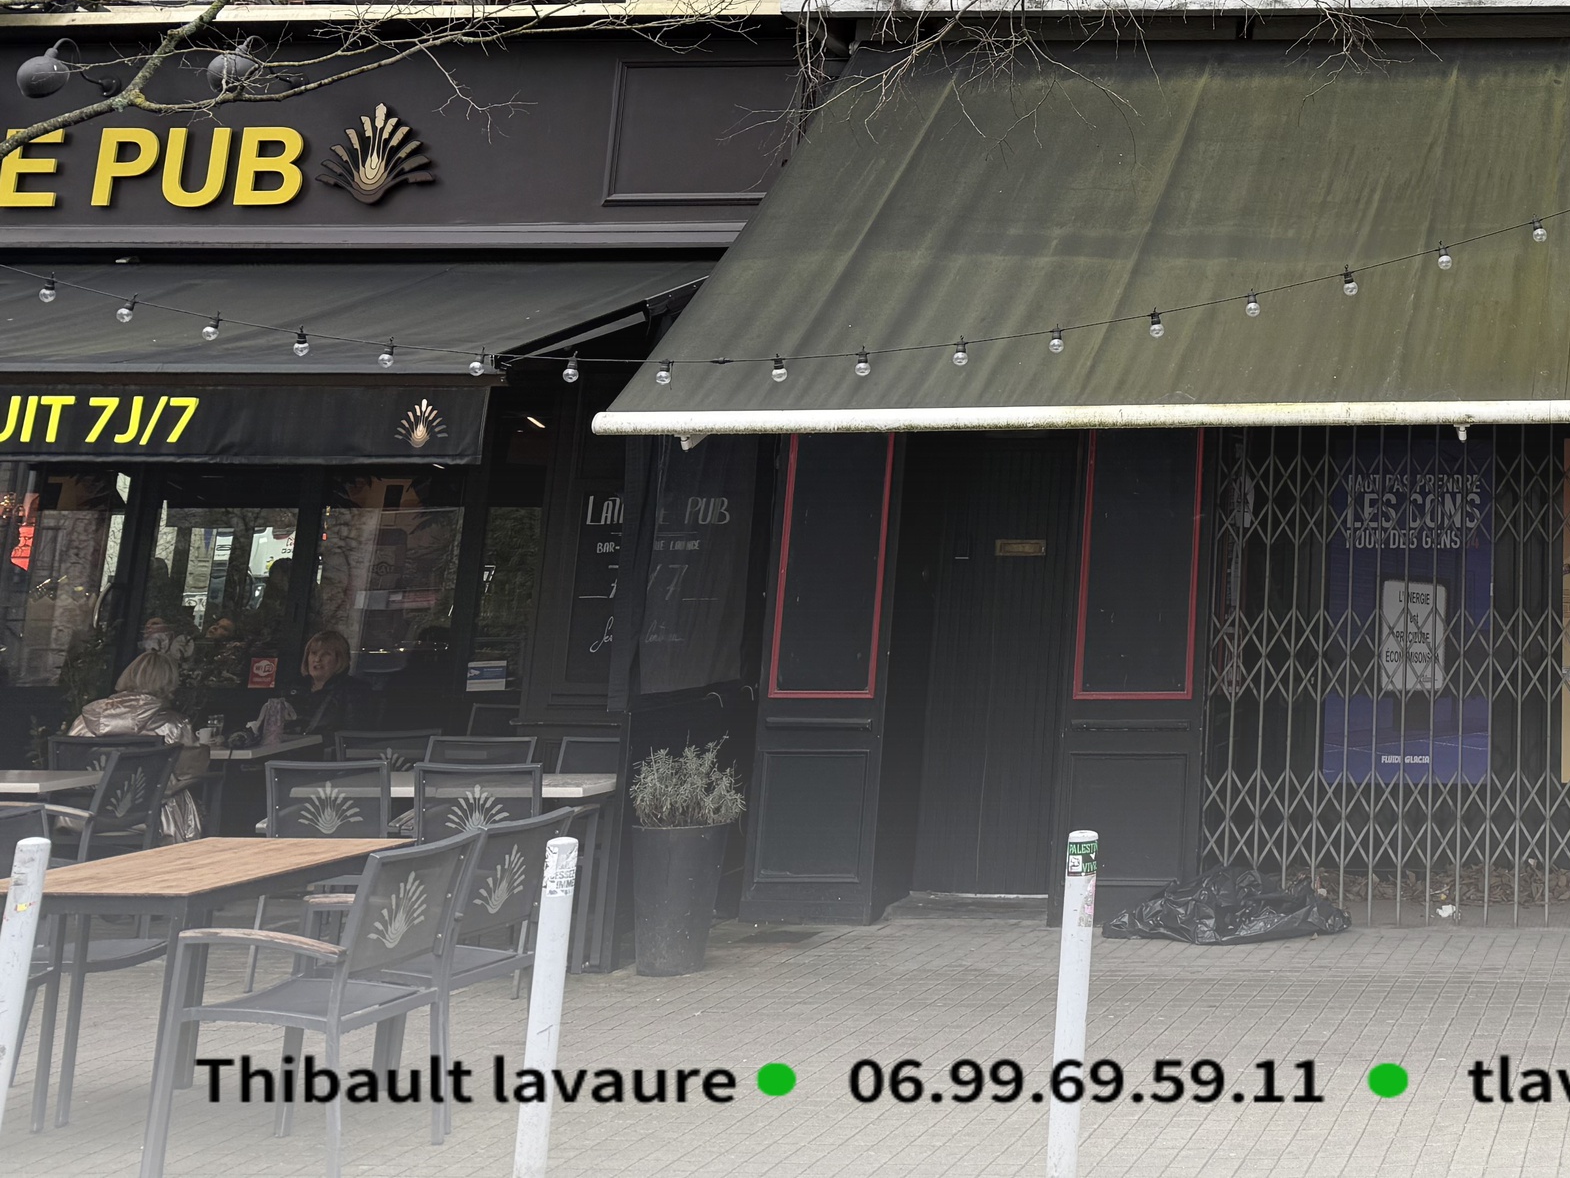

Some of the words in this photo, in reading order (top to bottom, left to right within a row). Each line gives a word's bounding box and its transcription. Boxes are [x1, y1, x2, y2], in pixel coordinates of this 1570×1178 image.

[91, 127, 304, 208] PUB
[85, 395, 200, 446] 7J/7
[1346, 493, 1397, 528] LES
[1409, 493, 1481, 528] CONS
[1398, 590, 1430, 605] L'NERGIE
[1404, 755, 1432, 764] GLACIA
